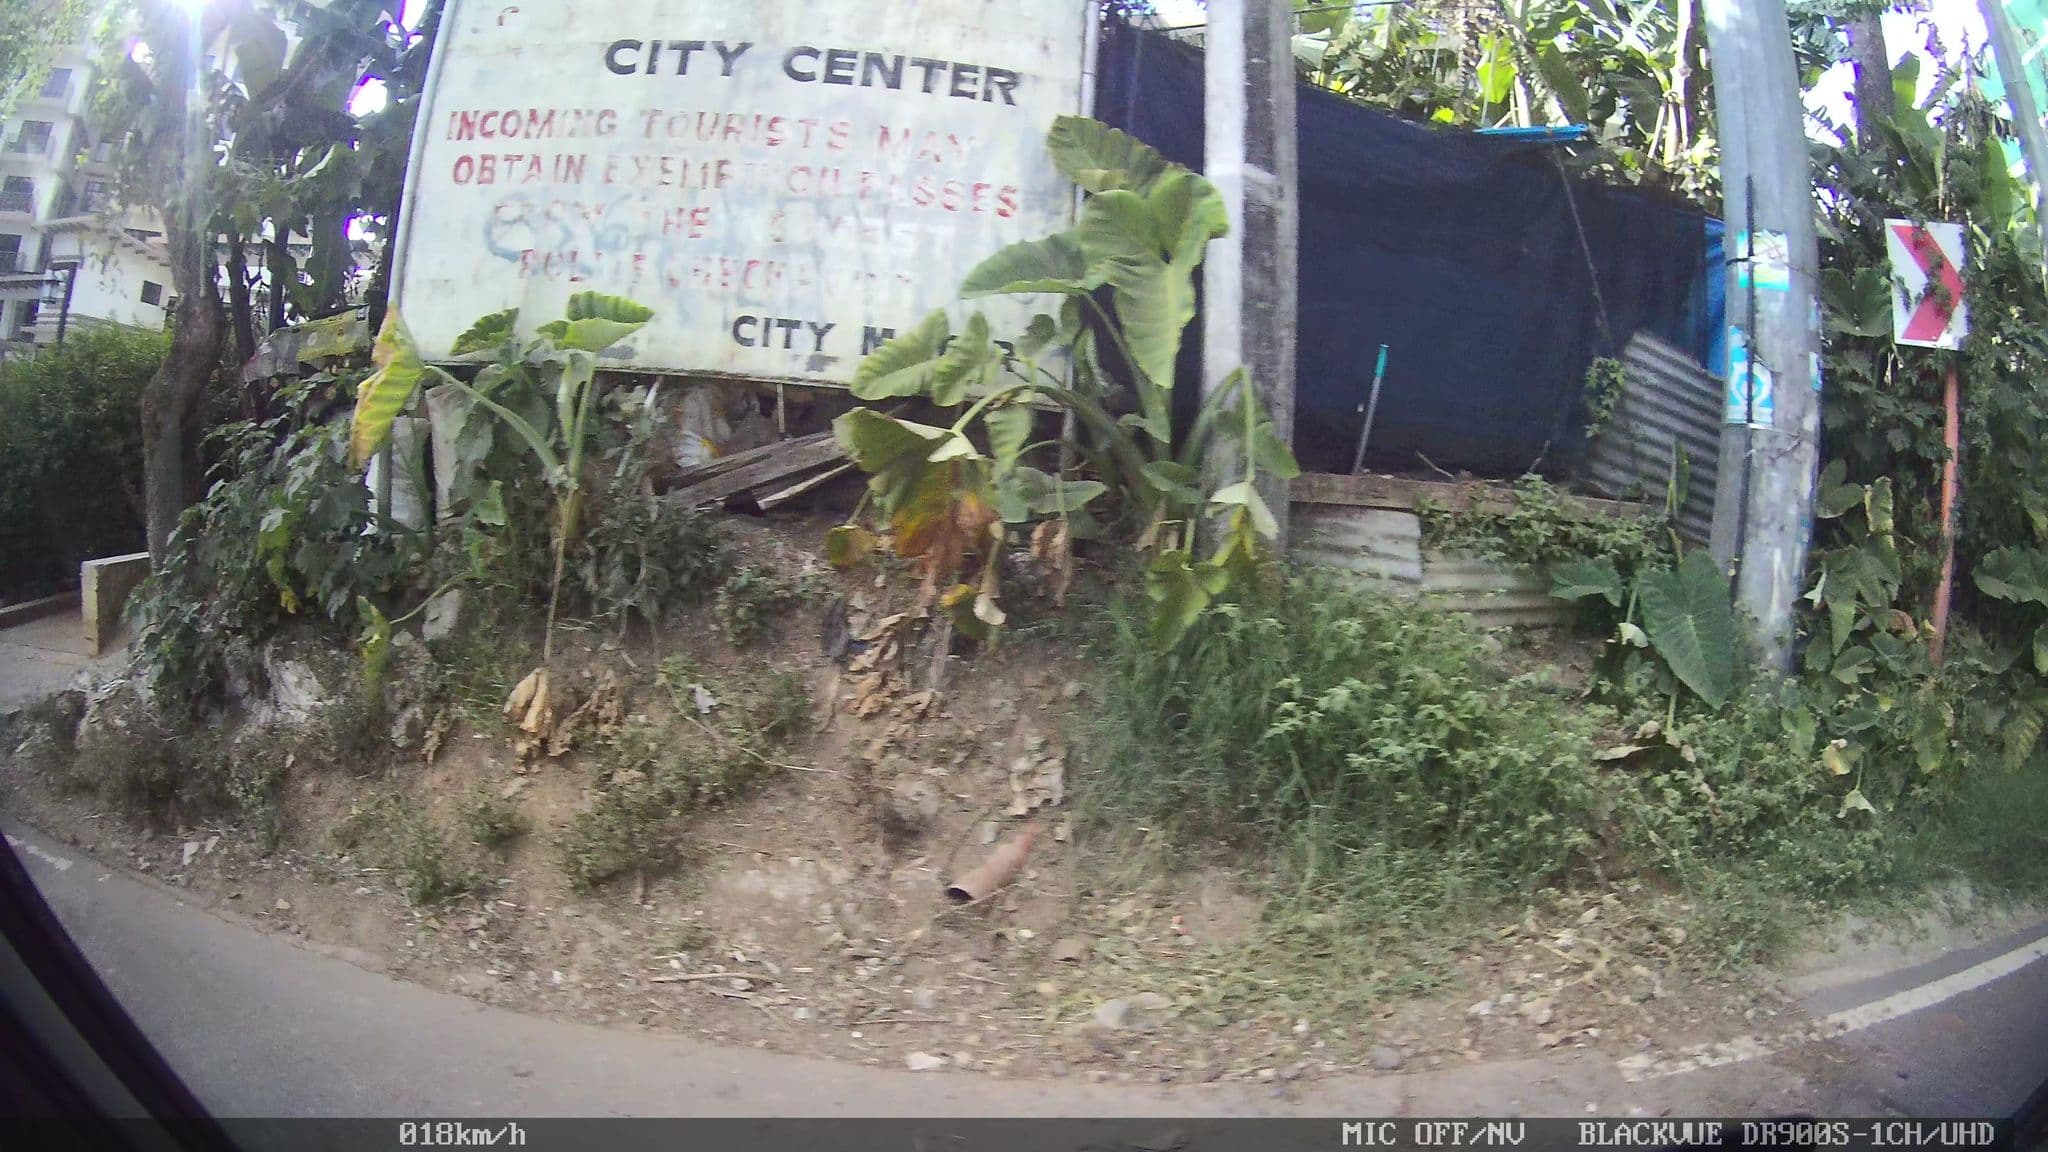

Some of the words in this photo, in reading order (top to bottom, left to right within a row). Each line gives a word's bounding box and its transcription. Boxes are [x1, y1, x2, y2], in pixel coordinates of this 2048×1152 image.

[605, 38, 754, 77] CITY
[783, 45, 1025, 106] CENTER
[446, 108, 618, 141] INCOMING
[640, 108, 850, 150] TOURISTS
[452, 153, 588, 185] OBTAIN
[732, 315, 836, 351] CITY
